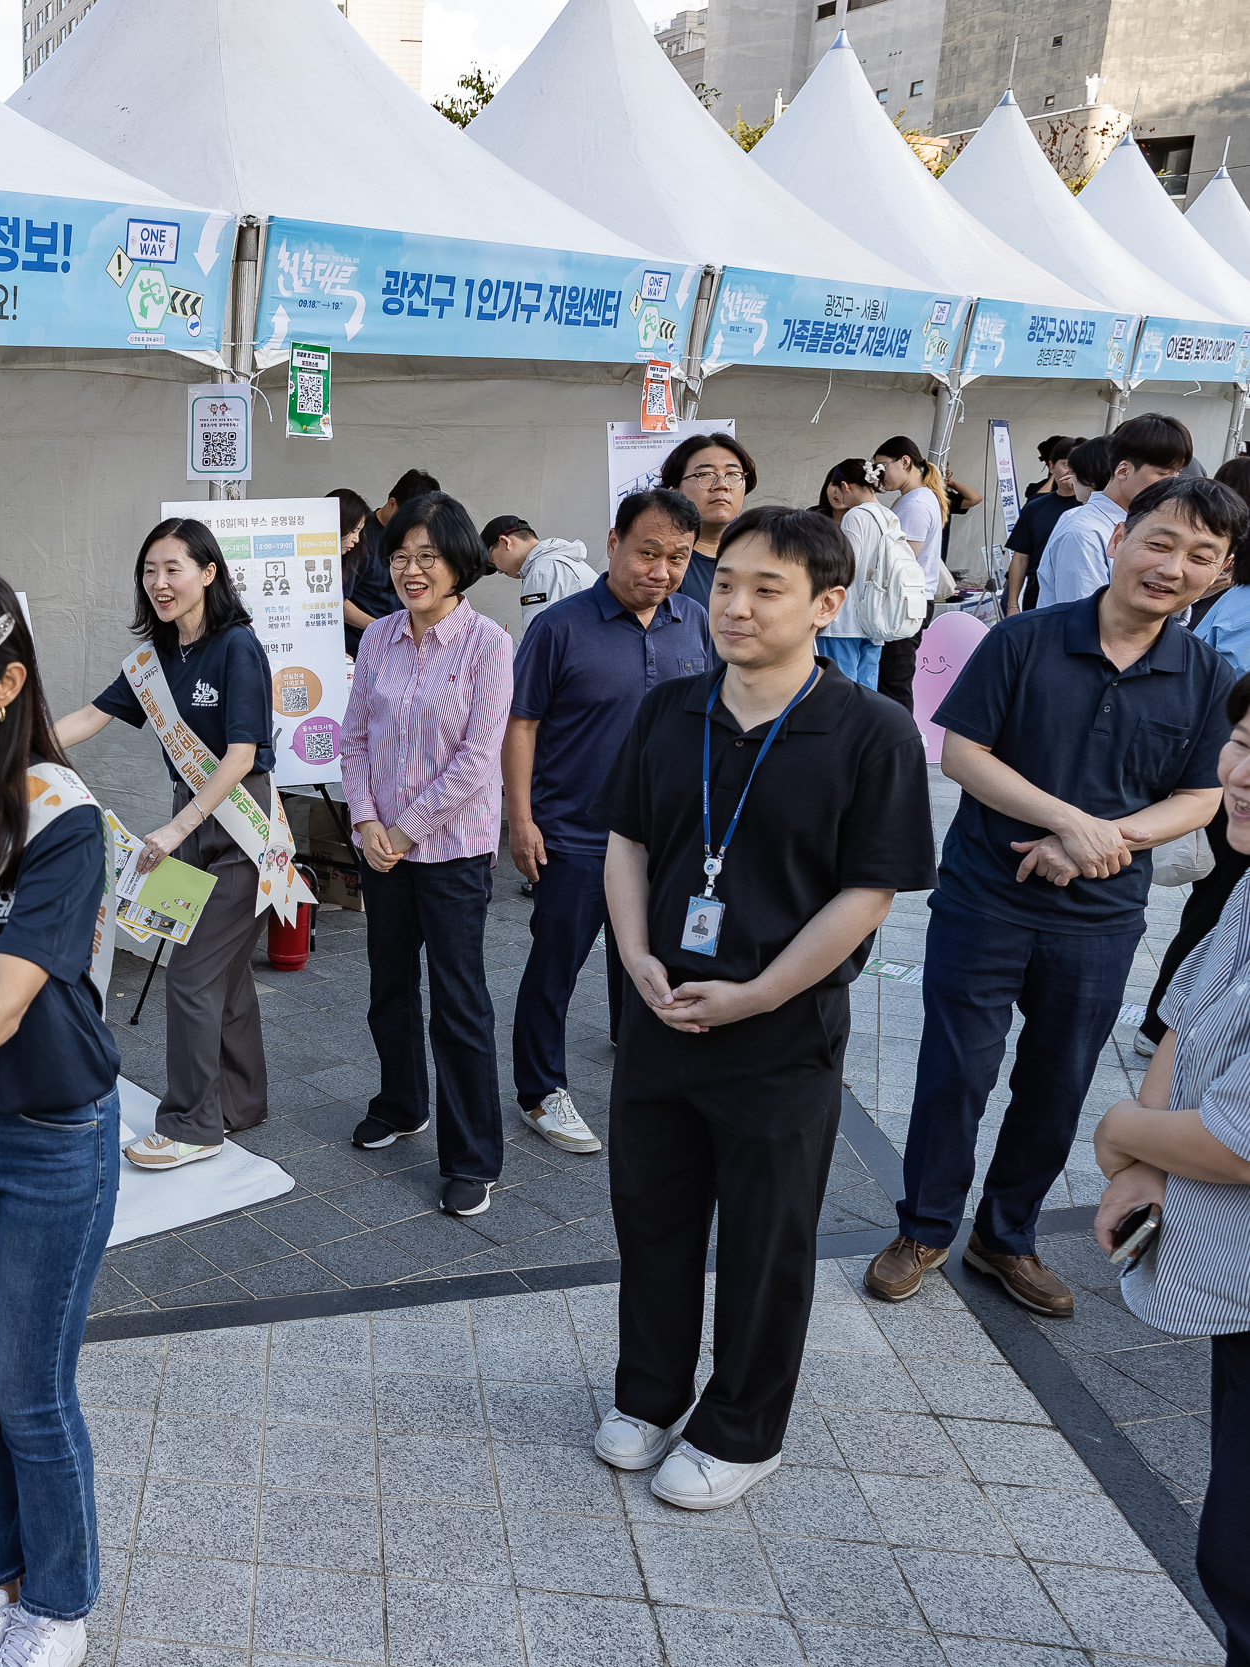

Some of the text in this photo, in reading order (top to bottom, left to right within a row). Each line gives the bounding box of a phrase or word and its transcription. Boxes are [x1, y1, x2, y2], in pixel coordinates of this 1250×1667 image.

[140, 227, 166, 243] ONE
[139, 242, 165, 257] WAY
[649, 277, 663, 288] ONE
[382, 270, 622, 328] 광진구 1인가구 지원센터
[647, 287, 661, 297] WAY
[825, 295, 854, 319] 광진구
[861, 299, 888, 321] 서울시
[1027, 316, 1057, 343] 광진구
[1056, 319, 1079, 343] SNS
[1078, 322, 1096, 345] 타고
[778, 319, 912, 358] 가족돌봄청년 지원사업
[1036, 348, 1076, 367] 청춘대로 직진
[216, 517, 247, 528] 18일(목)
[251, 517, 267, 527] 부스
[271, 515, 305, 526] 운영일정
[220, 544, 249, 552] 00~18:00
[255, 542, 293, 551] 18:00~19:00
[298, 540, 336, 549] 19:00~20:00
[262, 644, 293, 655] 계약 TIP
[140, 687, 207, 791] 전월세 안심 도움
[229, 786, 269, 842] 용하세요
